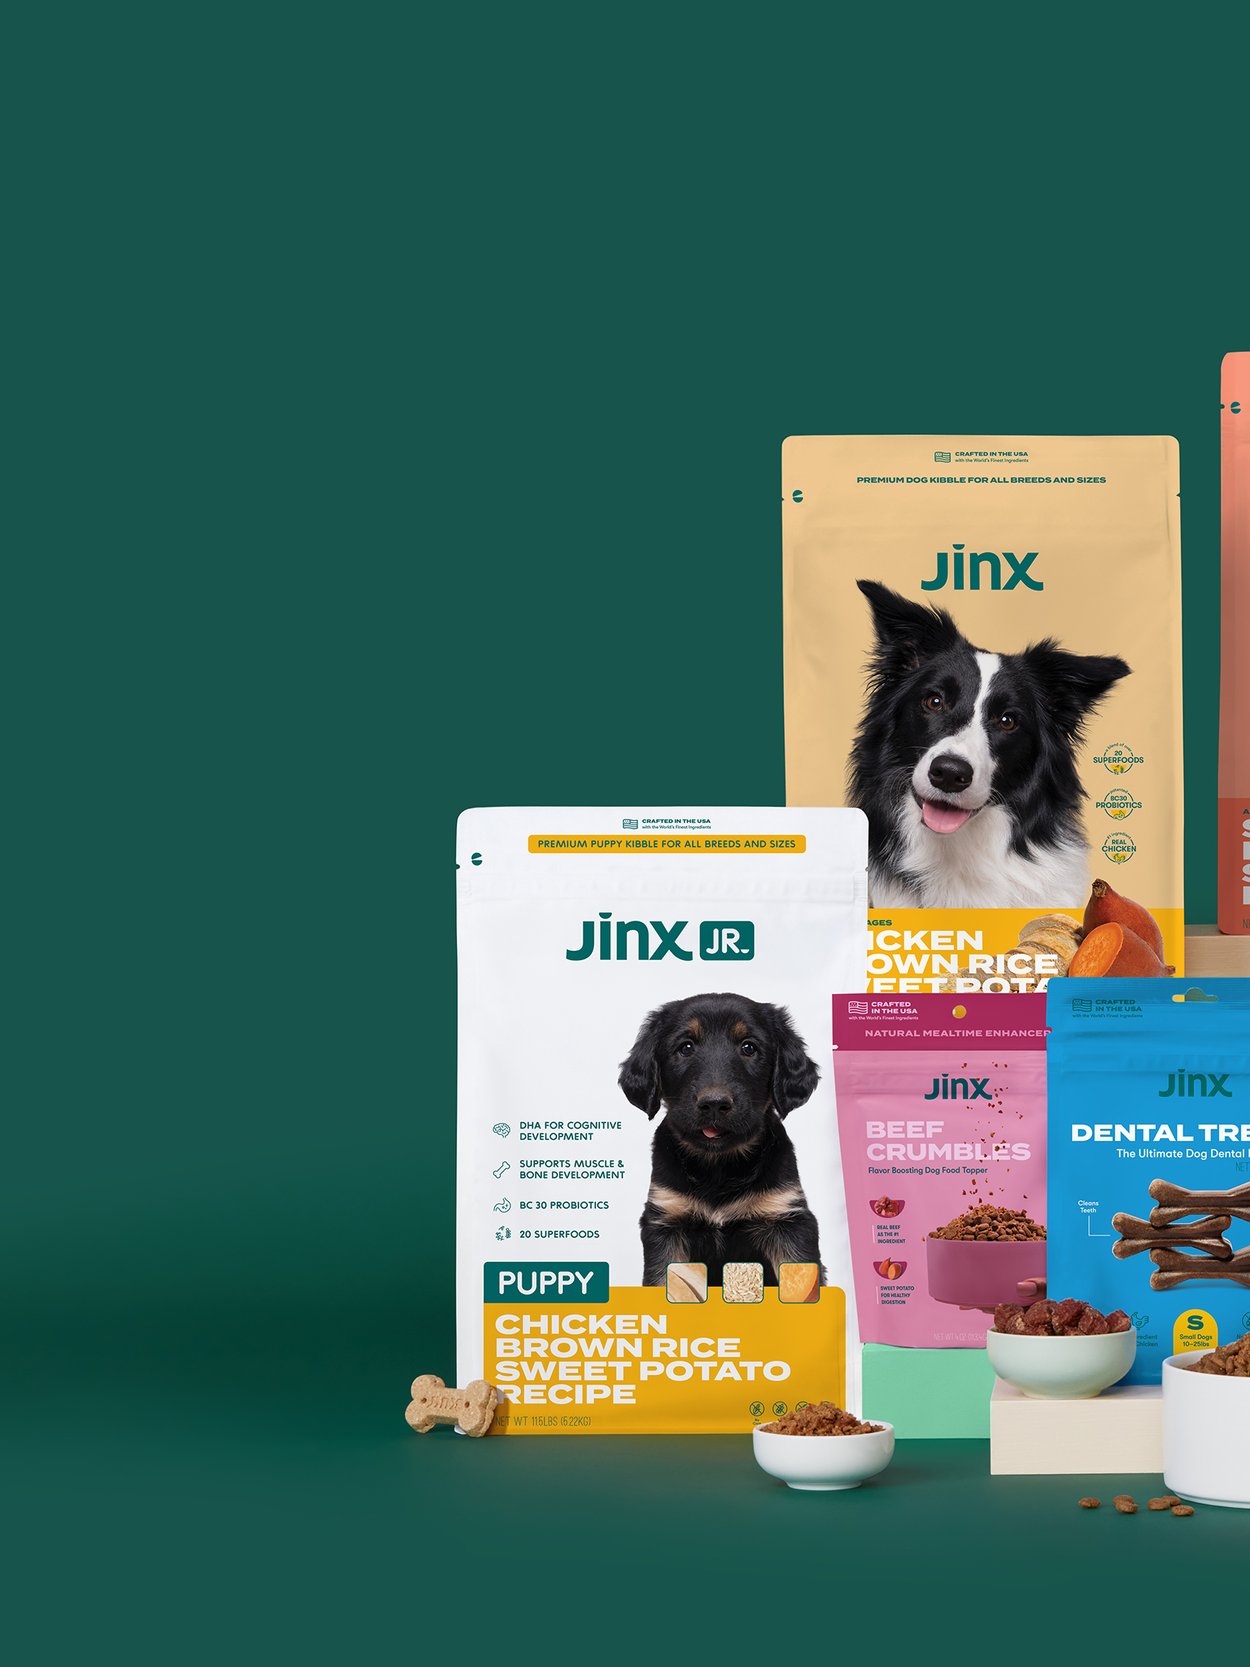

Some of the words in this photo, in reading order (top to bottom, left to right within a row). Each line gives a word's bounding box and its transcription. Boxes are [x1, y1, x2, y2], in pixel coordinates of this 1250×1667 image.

[537, 839, 588, 849] PREMIUM
[590, 839, 623, 849] PUPPY
[625, 839, 658, 849] KIBBLE
[661, 839, 681, 849] FOR
[684, 840, 702, 848] ALL
[704, 839, 741, 849] BREEDS
[744, 839, 767, 848] AND
[769, 839, 796, 849] SIZES
[866, 930, 983, 951] ICKEN
[866, 953, 958, 975] OWN
[968, 953, 1059, 975] RICE
[519, 1121, 542, 1130] DHA
[544, 1121, 564, 1130] FOR
[567, 1121, 622, 1130] COGNITIVE
[866, 1121, 945, 1139] BEEF
[1071, 1124, 1194, 1142] DENTAL
[519, 1132, 594, 1141] DEVELOPMENT
[866, 1143, 1031, 1161] CRUMBLES
[1116, 1148, 1136, 1158] The
[1138, 1148, 1183, 1158] Ultimate
[1186, 1148, 1208, 1161] Dog
[1210, 1148, 1245, 1158] Dental
[519, 1159, 571, 1168] SUPPORTS
[573, 1159, 615, 1168] MUSCLE
[868, 1166, 890, 1174] Flavor
[891, 1166, 924, 1176] Boosting
[924, 1166, 941, 1176] Dog
[941, 1166, 961, 1174] Food
[962, 1166, 988, 1175] Topper
[519, 1170, 548, 1179] BONE
[551, 1171, 625, 1179] DEVELOPMENT
[519, 1201, 533, 1210] BC
[535, 1201, 547, 1210] 30
[550, 1201, 609, 1210] PROBIOTICS
[519, 1230, 532, 1239] 20
[534, 1230, 600, 1239] SUPERFOODS
[499, 1271, 594, 1295] PUPPY
[495, 1314, 667, 1335] CHICKEN
[1186, 1315, 1204, 1331] S
[1179, 1333, 1197, 1343] Small
[1197, 1333, 1213, 1343] Dogs
[495, 1337, 642, 1358] BROWN
[652, 1337, 741, 1358] RICE
[495, 1360, 632, 1381] SWEET
[639, 1360, 791, 1382] POTATO
[495, 1384, 637, 1405] RECIPE
